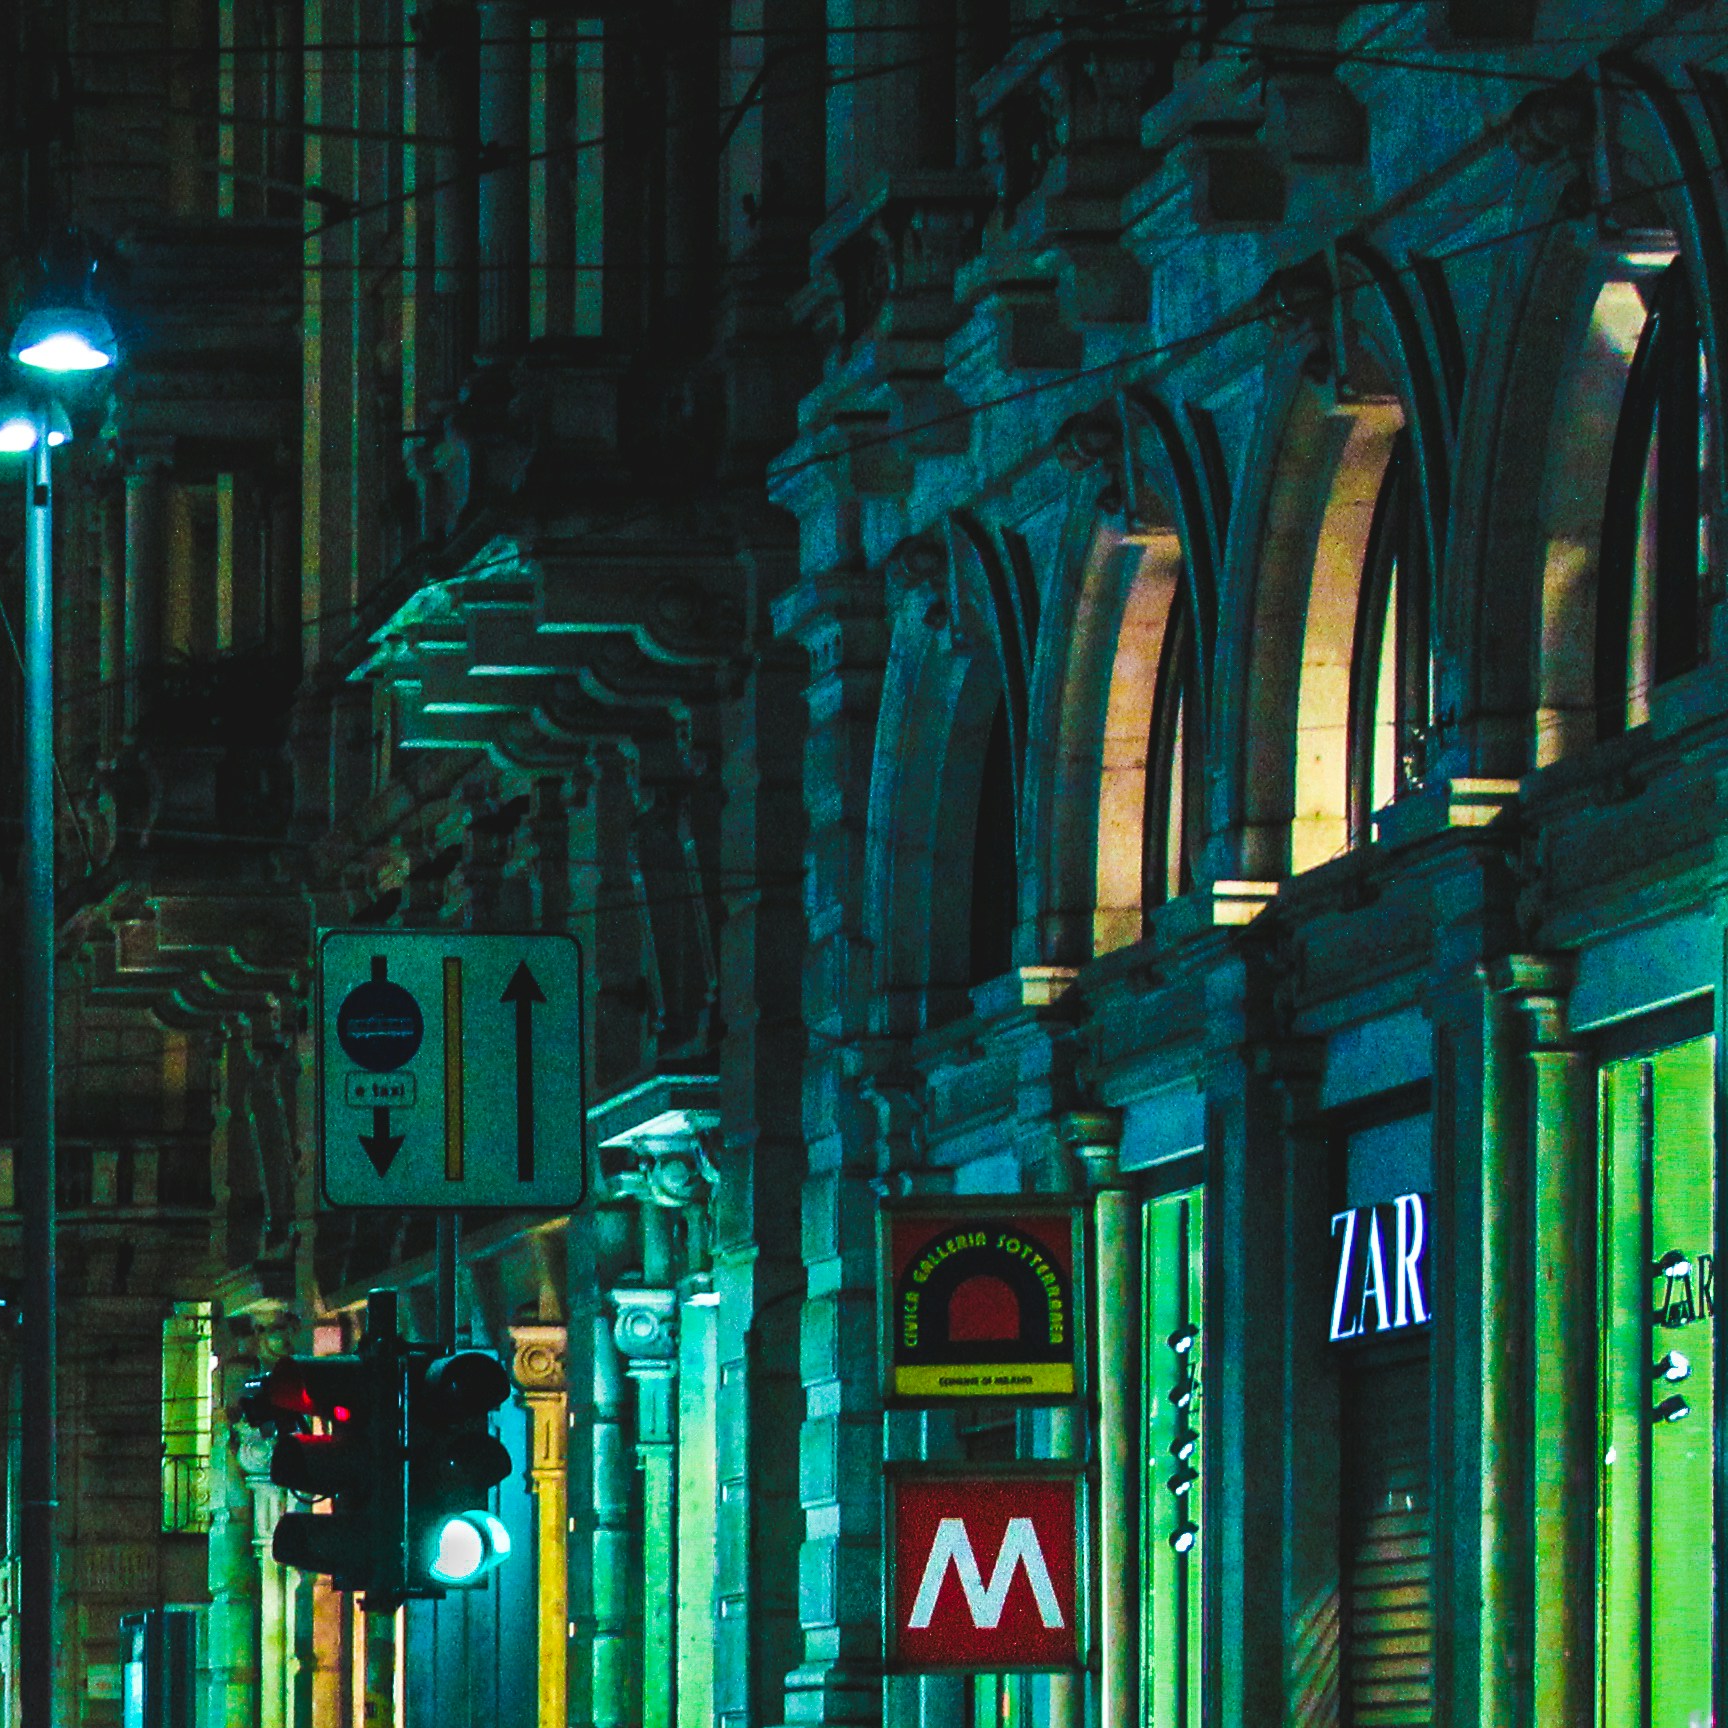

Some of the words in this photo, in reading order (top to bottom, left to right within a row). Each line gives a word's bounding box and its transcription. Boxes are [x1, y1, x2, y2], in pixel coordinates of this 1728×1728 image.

[903, 1290, 920, 1347] CIVICA
[913, 1231, 988, 1284] GALLERIA
[1328, 1192, 1432, 1343] ZAR
[907, 1517, 1065, 1628] M
